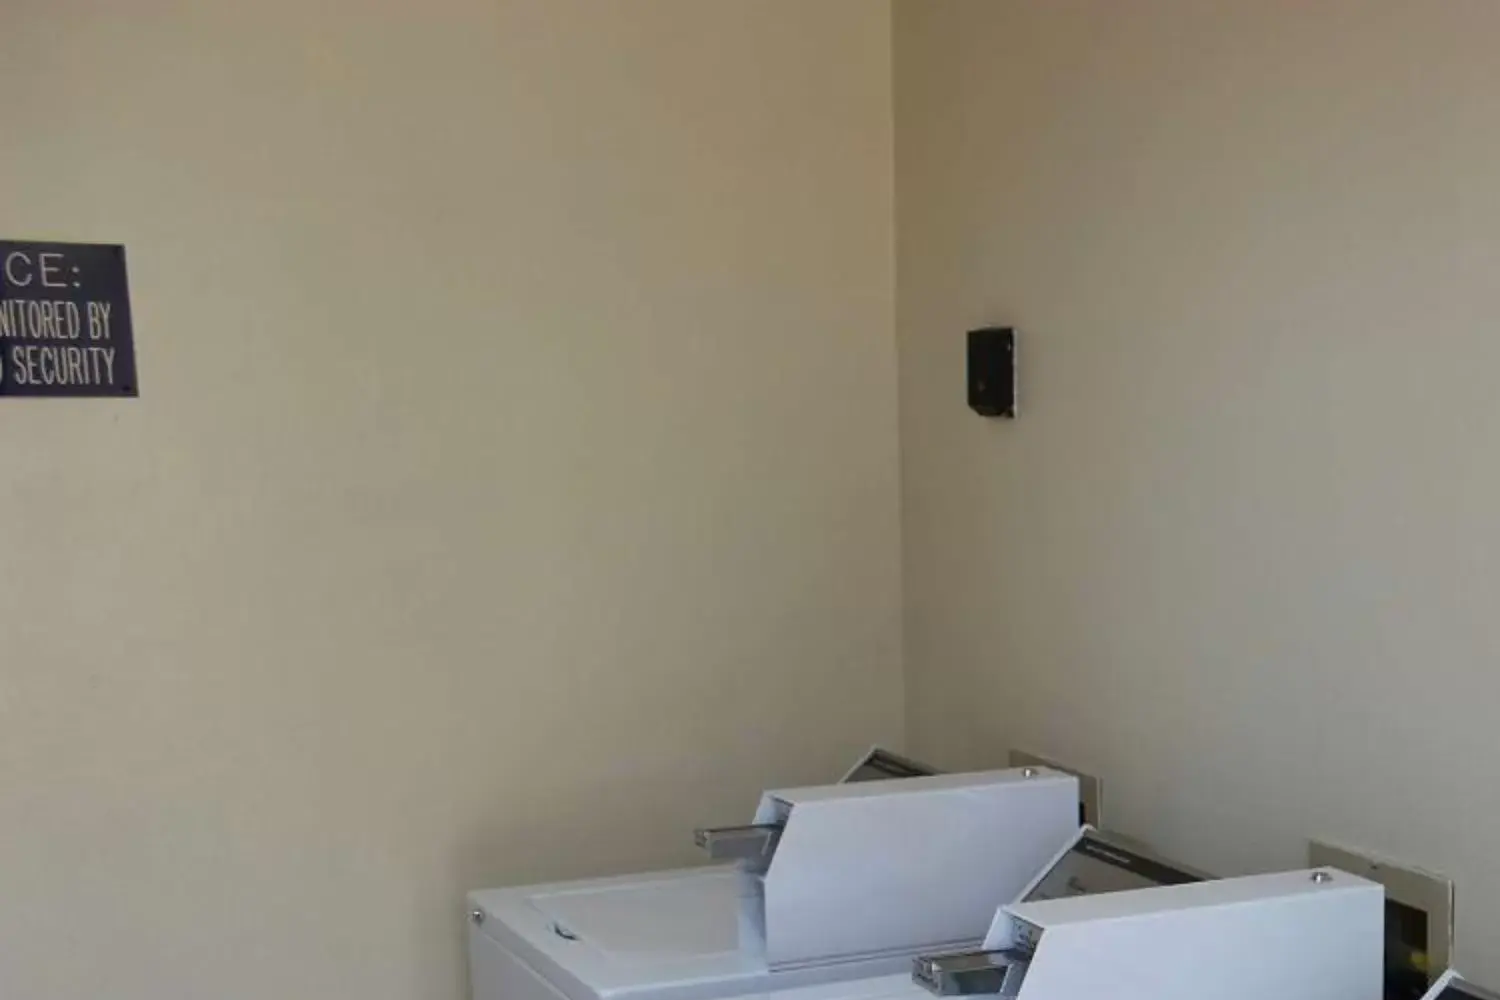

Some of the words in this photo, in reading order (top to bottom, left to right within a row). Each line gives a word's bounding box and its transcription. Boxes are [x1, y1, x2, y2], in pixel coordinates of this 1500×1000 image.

[5, 251, 80, 287] CE:
[87, 302, 111, 339] BY
[12, 345, 115, 385] SECURITY
